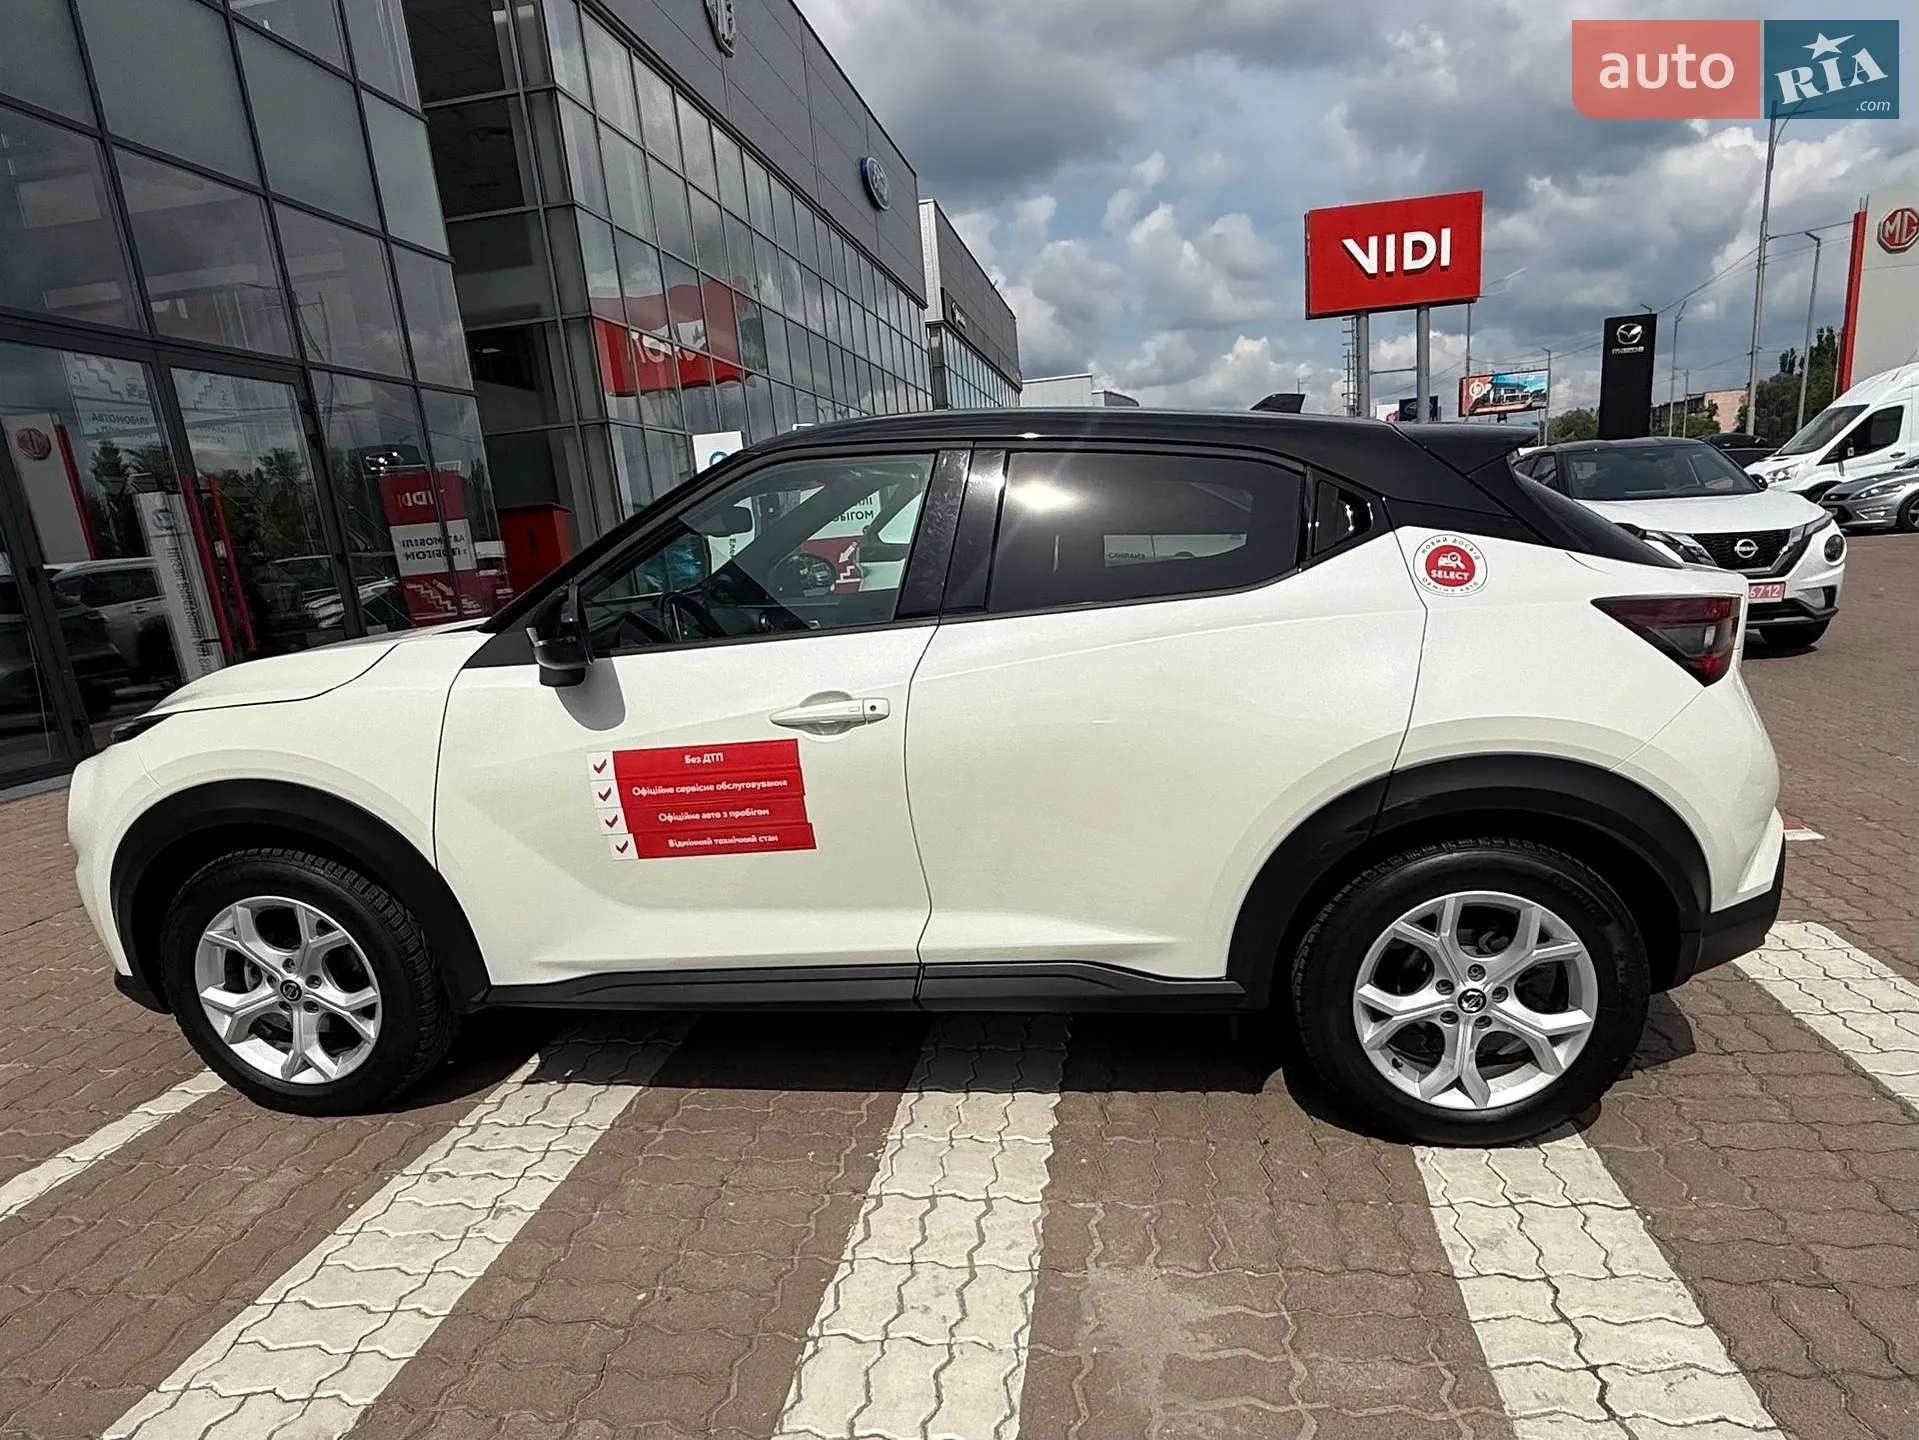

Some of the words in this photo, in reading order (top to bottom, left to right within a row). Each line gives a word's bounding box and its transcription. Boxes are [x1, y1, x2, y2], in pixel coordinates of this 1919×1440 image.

[1884, 211, 1919, 244] MG
[1341, 227, 1451, 275] VIDI
[1430, 569, 1470, 581] SELECT
[684, 754, 701, 765] Без
[703, 752, 724, 765] ДТП
[632, 785, 674, 797] Офіційне
[675, 783, 714, 793] сервісне
[716, 779, 788, 793] обслуговування
[658, 811, 700, 823] Офіційне
[701, 811, 721, 819] авто
[722, 810, 728, 818] з
[729, 807, 769, 819] пробігом
[668, 836, 713, 848] Відмінний
[713, 835, 757, 846] технічний
[758, 834, 778, 843] стан
